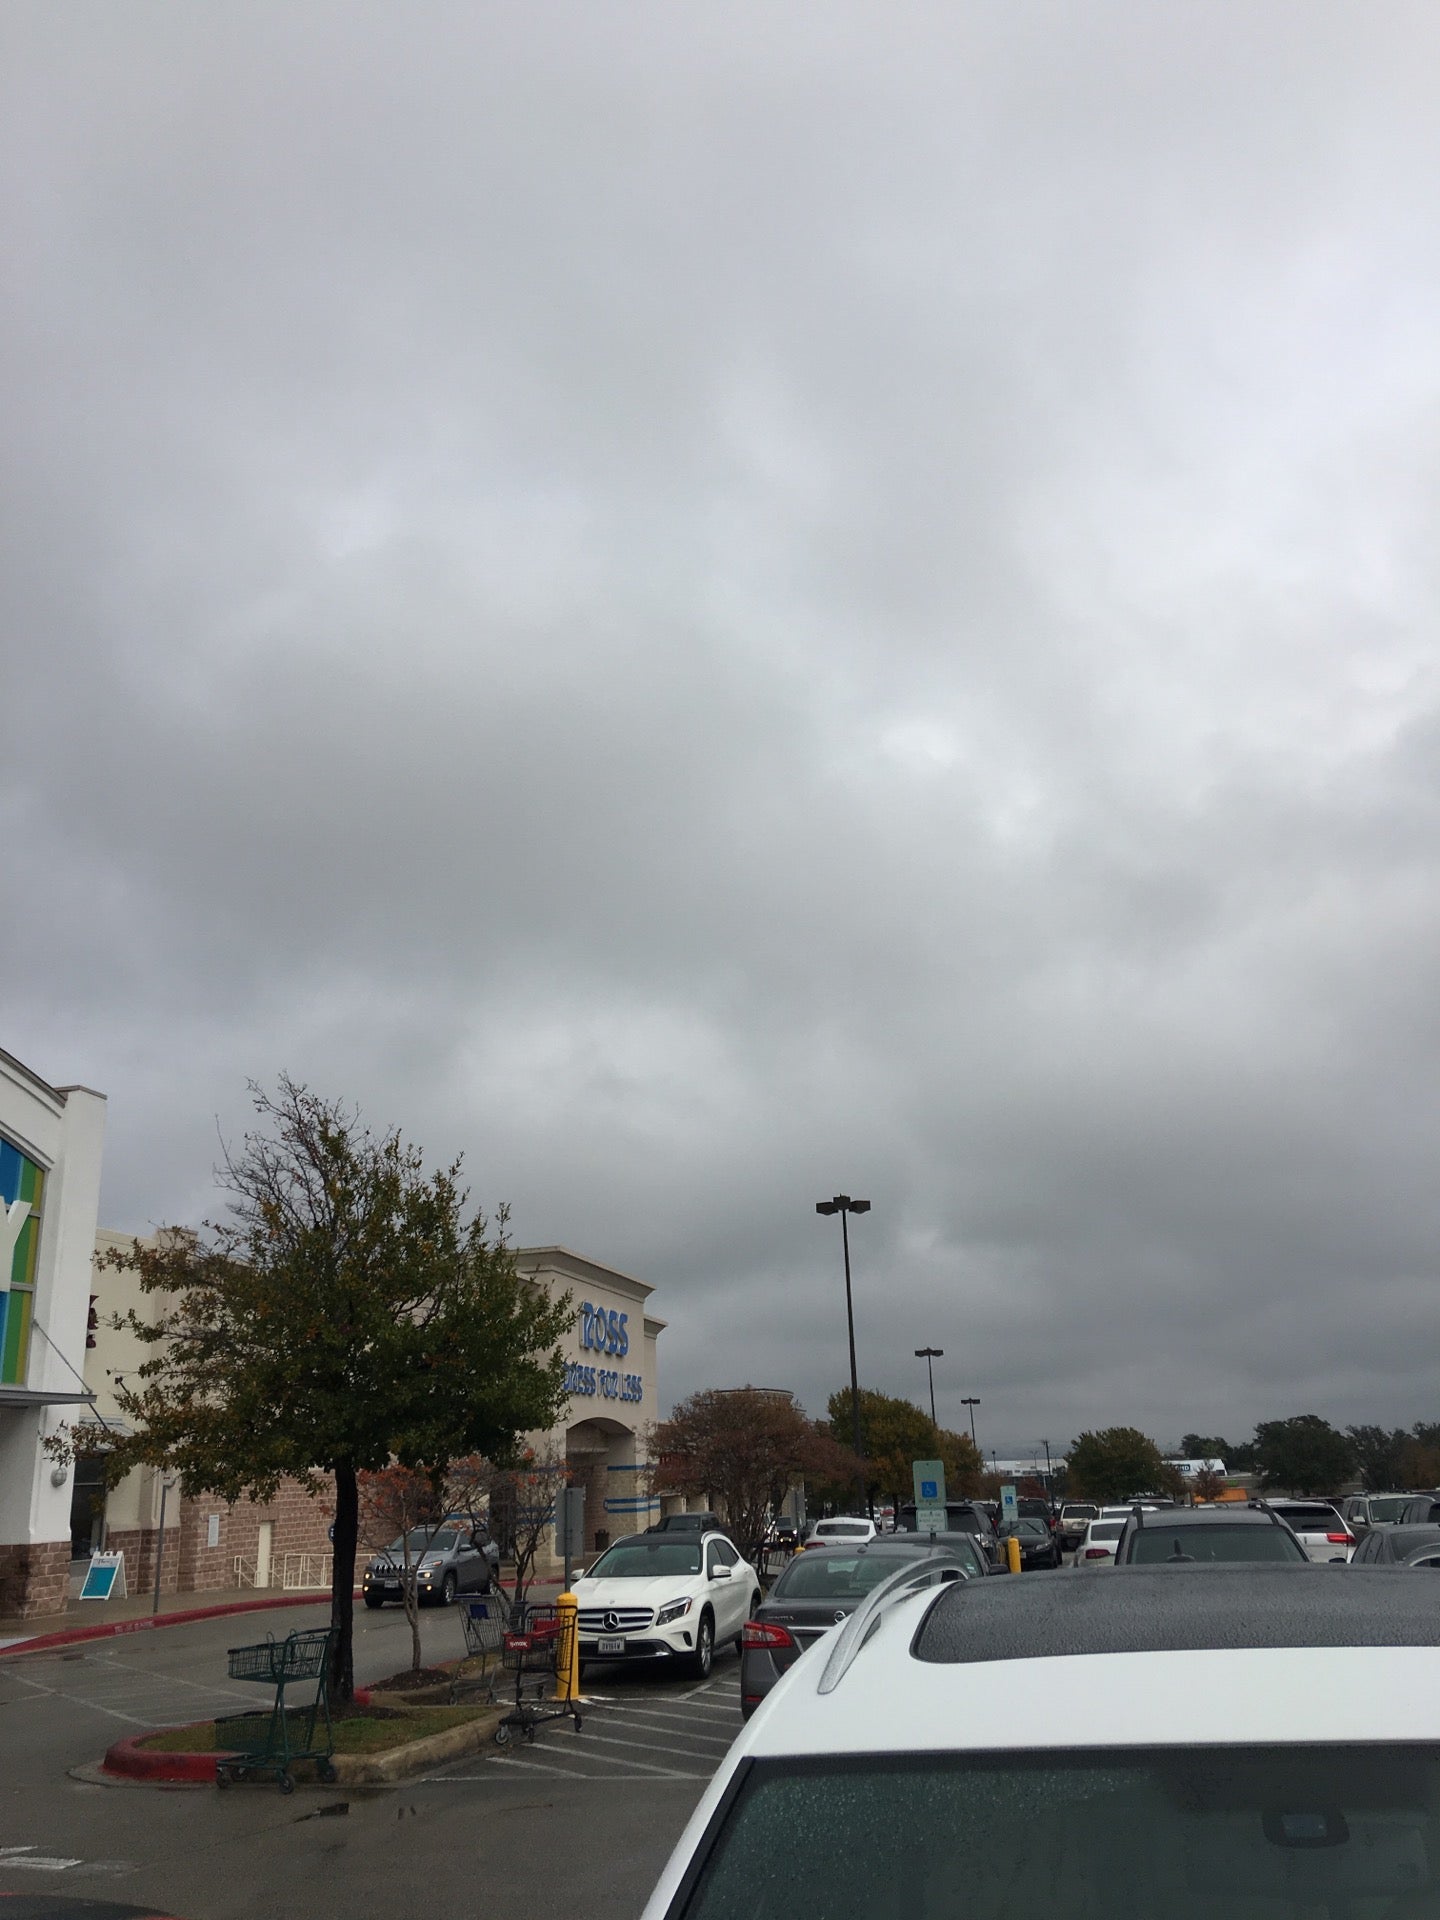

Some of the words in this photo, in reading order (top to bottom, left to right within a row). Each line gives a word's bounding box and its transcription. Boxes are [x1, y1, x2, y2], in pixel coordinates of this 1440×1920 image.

[0, 1196, 32, 1292] Y
[580, 1301, 628, 1357] ROSS
[597, 1368, 618, 1398] FOR
[619, 1372, 643, 1401] LESS
